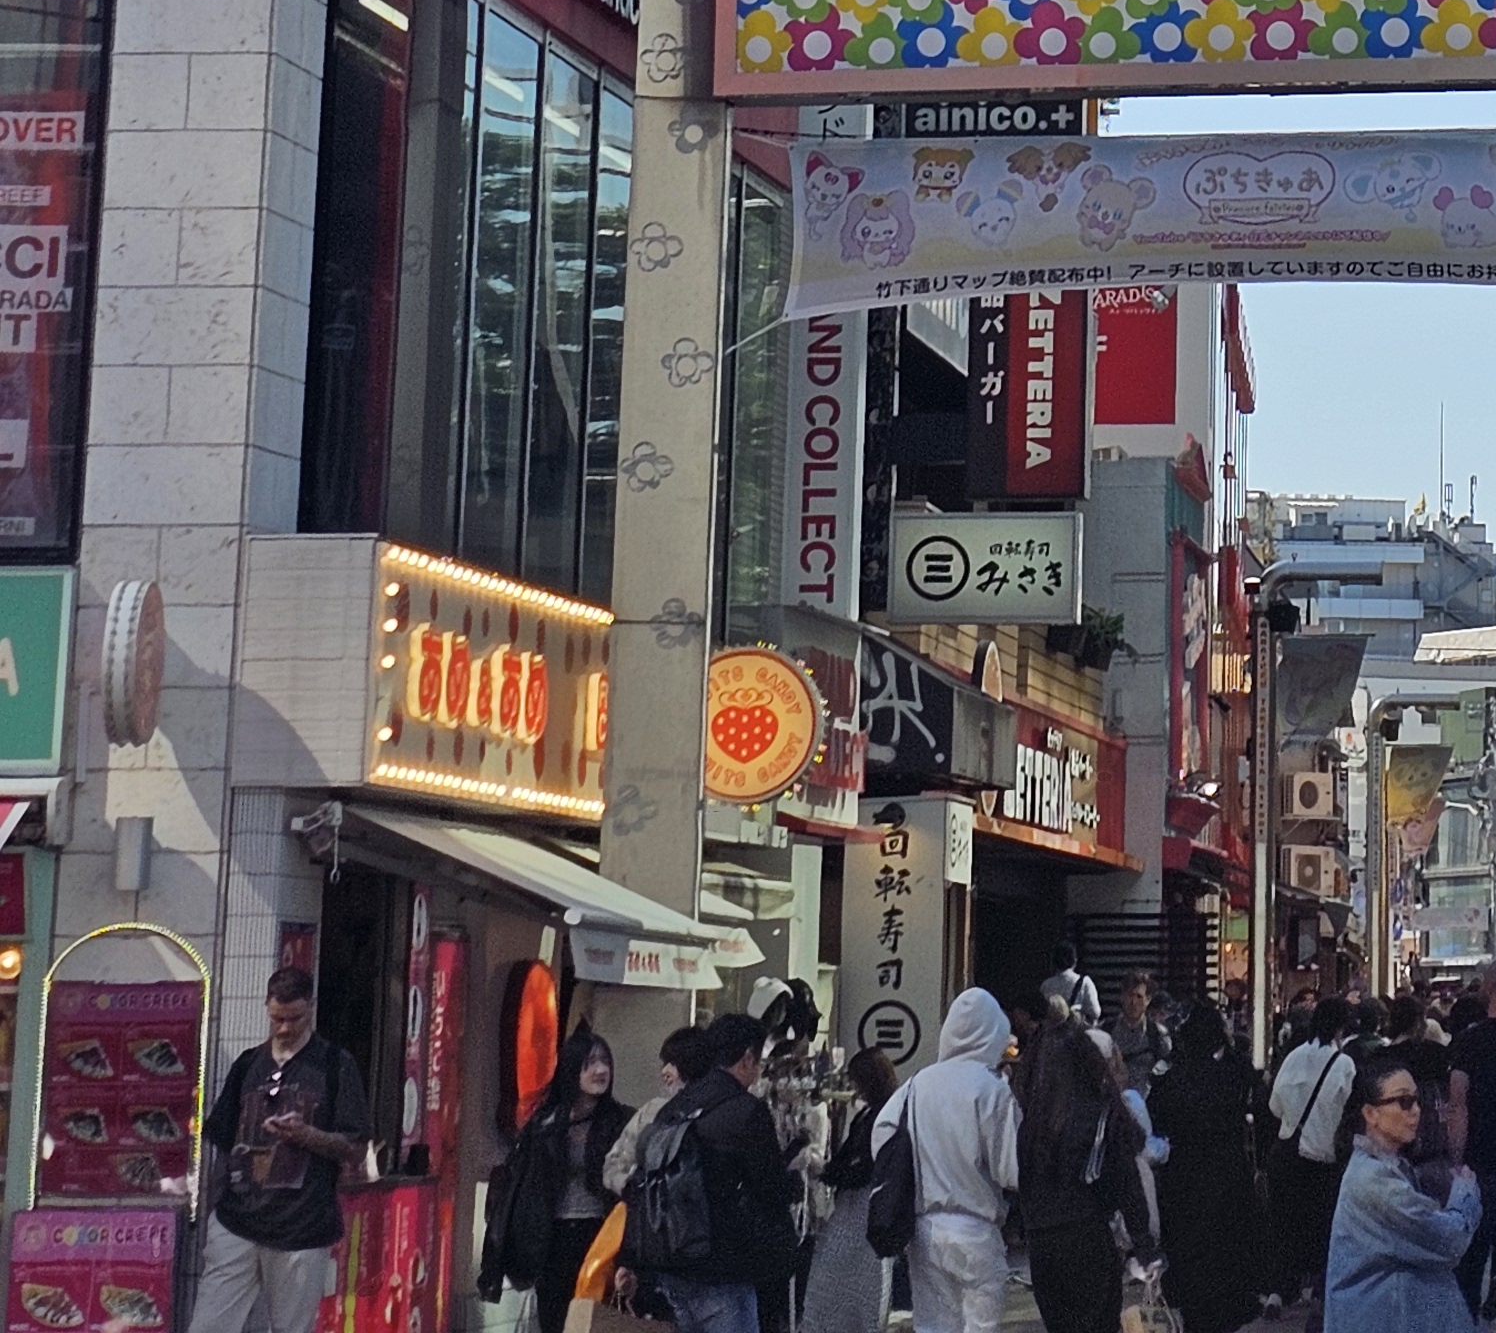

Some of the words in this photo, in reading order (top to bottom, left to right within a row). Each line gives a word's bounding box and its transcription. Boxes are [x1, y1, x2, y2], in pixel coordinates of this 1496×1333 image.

[1195, 167, 1324, 195] ぷちきゅあ
[0, 235, 60, 279] CI
[799, 394, 841, 604] COLLECT
[976, 560, 1063, 596] みさき
[873, 830, 912, 990] 回転寿司
